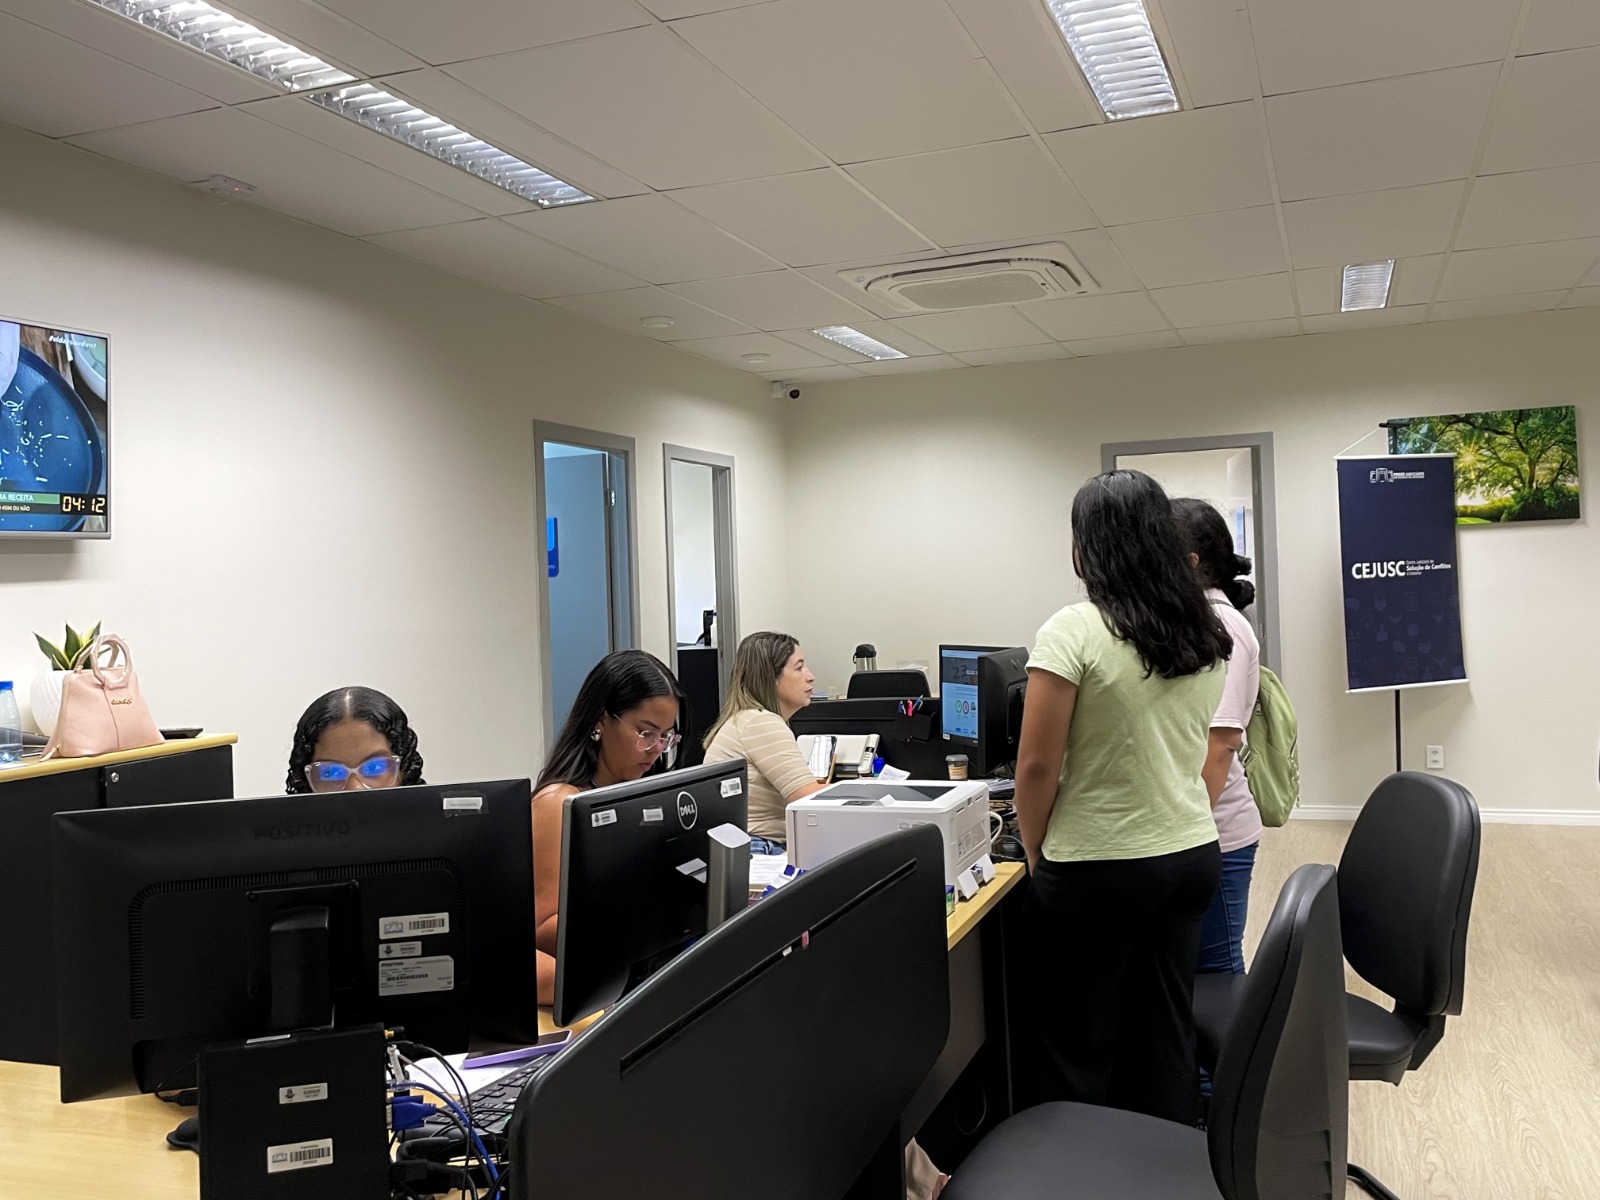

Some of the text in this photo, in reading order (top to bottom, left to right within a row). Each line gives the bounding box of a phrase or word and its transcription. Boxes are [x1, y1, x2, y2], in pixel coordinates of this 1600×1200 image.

[8, 494, 34, 502] RECEITA
[62, 496, 105, 513] 04:12
[1352, 561, 1405, 579] CEJUSC
[680, 804, 695, 816] DELL
[254, 820, 351, 842] POSITIVO
